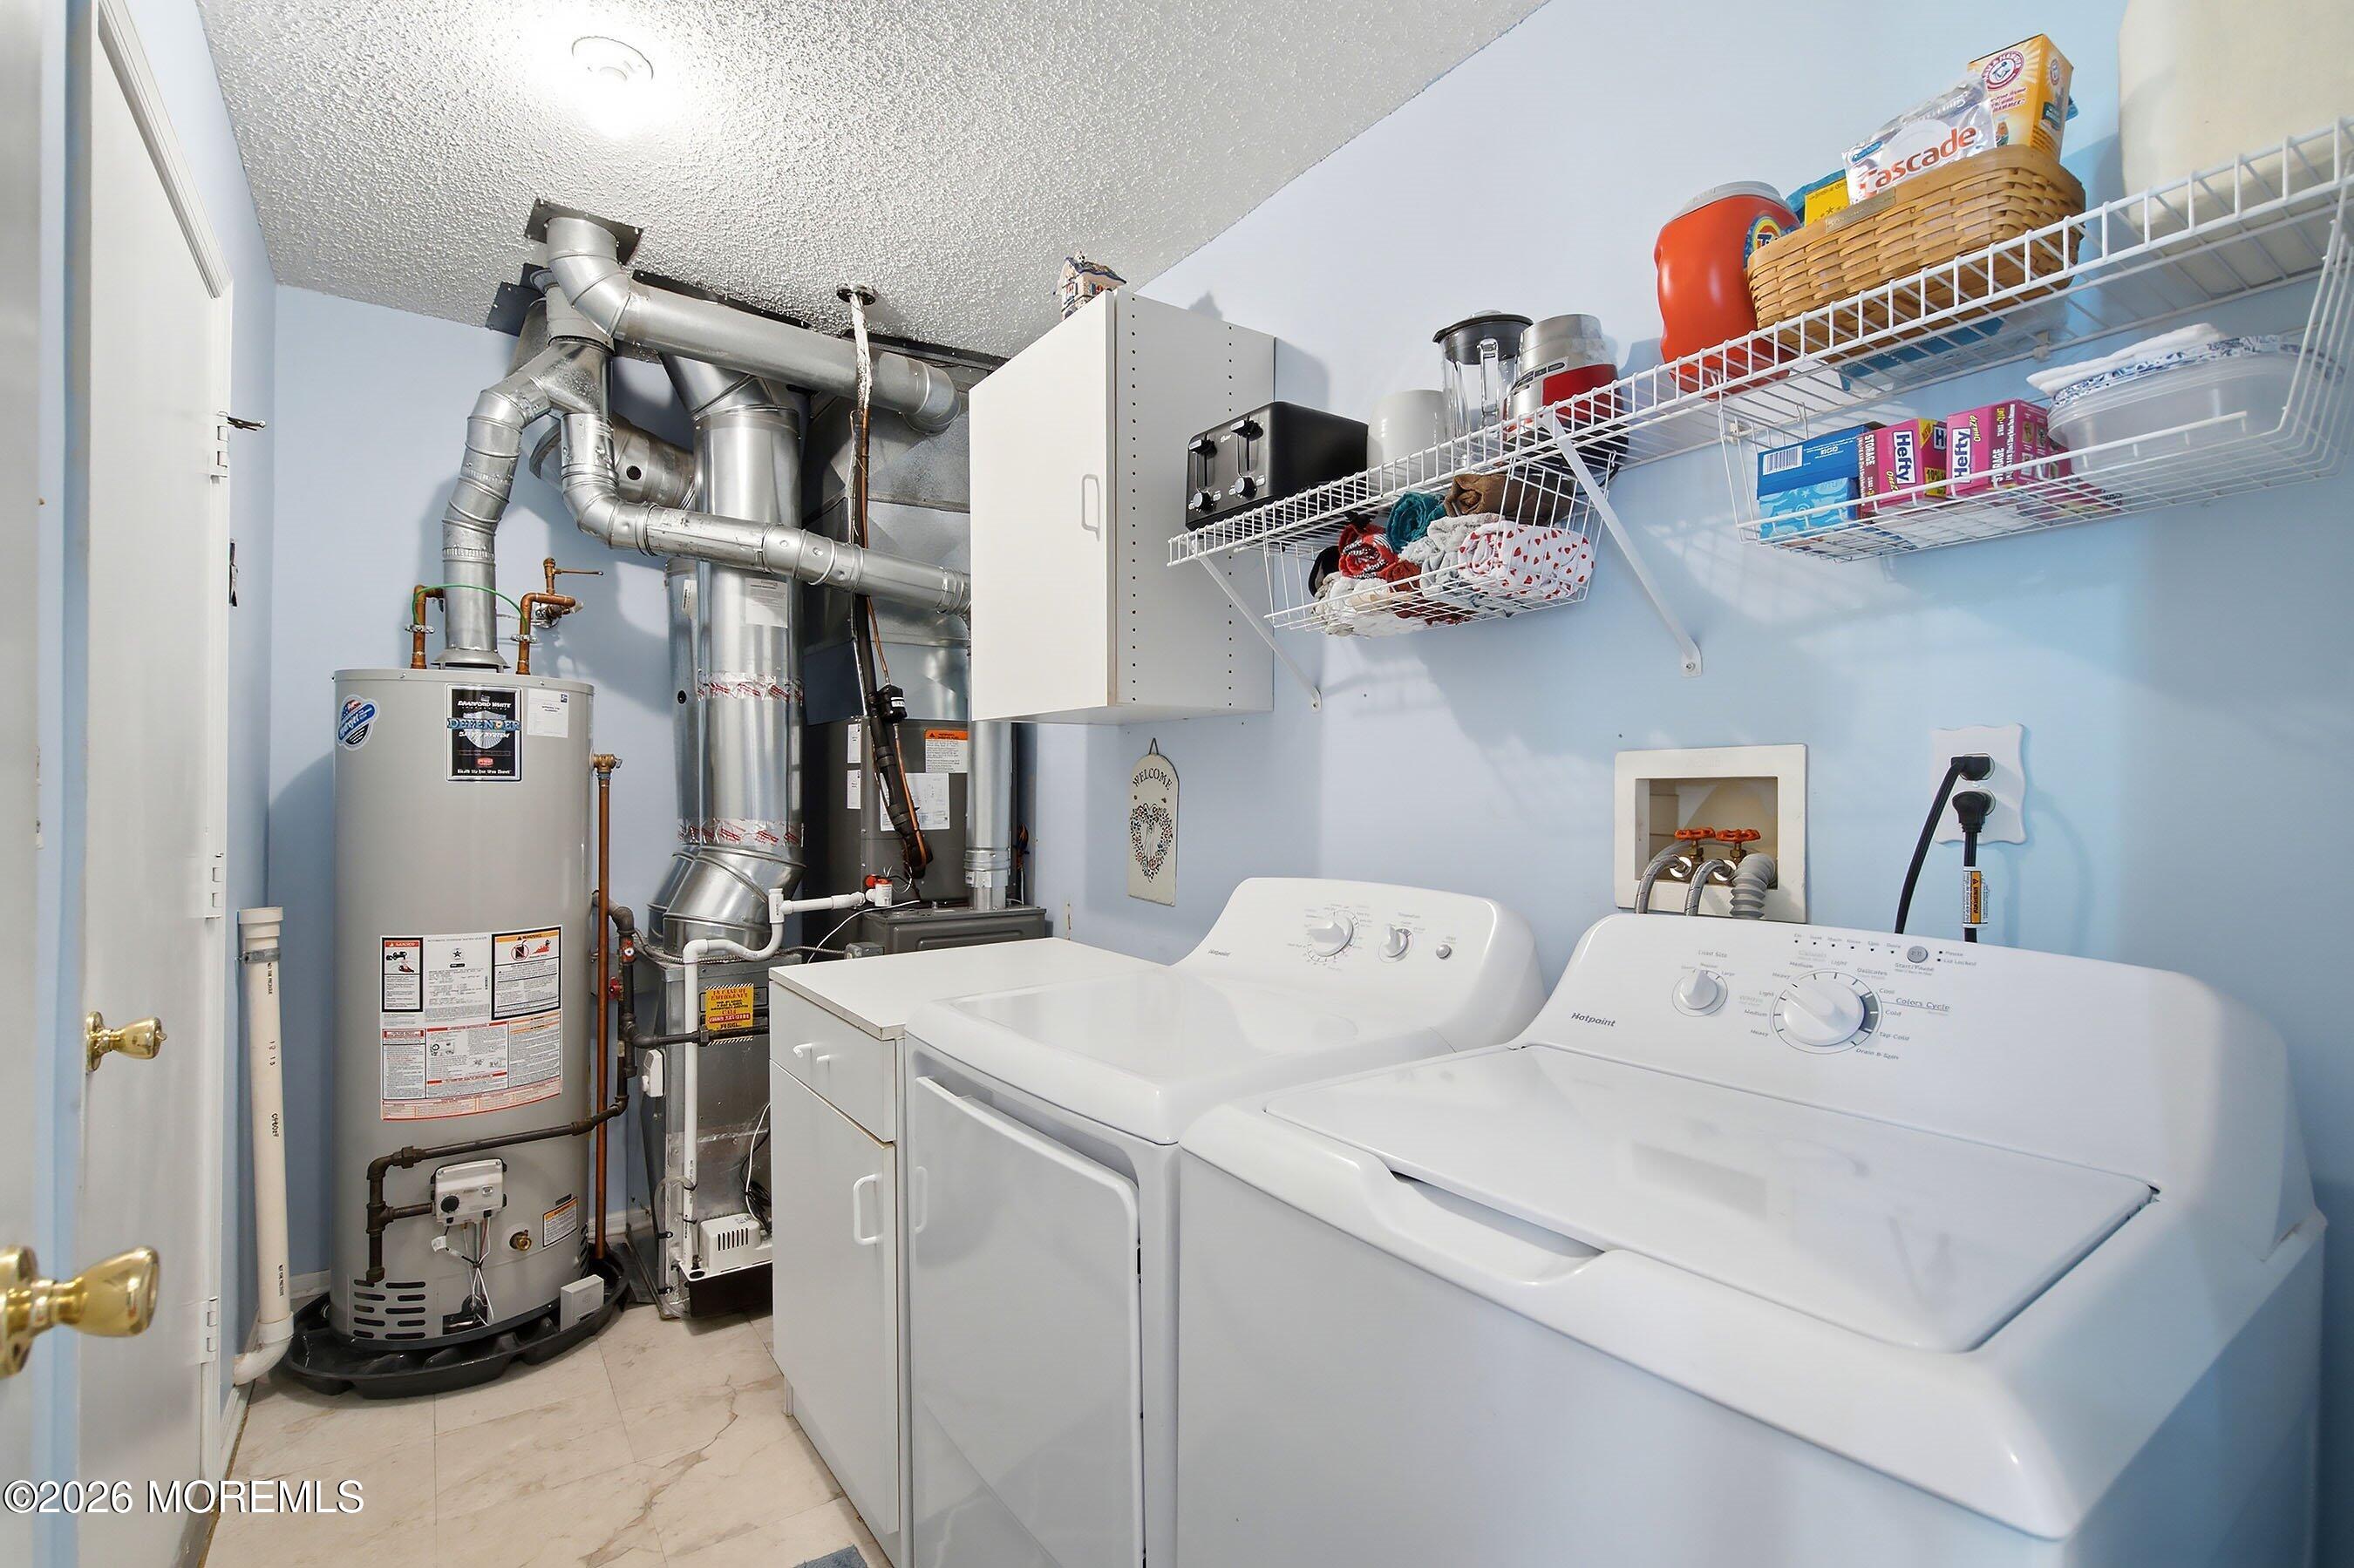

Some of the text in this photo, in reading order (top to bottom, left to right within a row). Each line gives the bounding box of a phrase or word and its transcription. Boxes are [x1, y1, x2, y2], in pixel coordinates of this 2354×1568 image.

[1865, 434, 1875, 467] STORAGE
[1896, 434, 1912, 481] Hefty
[1954, 431, 1970, 479] Hefty
[446, 717, 521, 732] DEFENDER
[1133, 767, 1172, 791] WELCOME
[1856, 967, 1888, 976] Delicates
[1895, 996, 1950, 1011] Colors Cycle
[1571, 1011, 1616, 1028] Hotpoint
